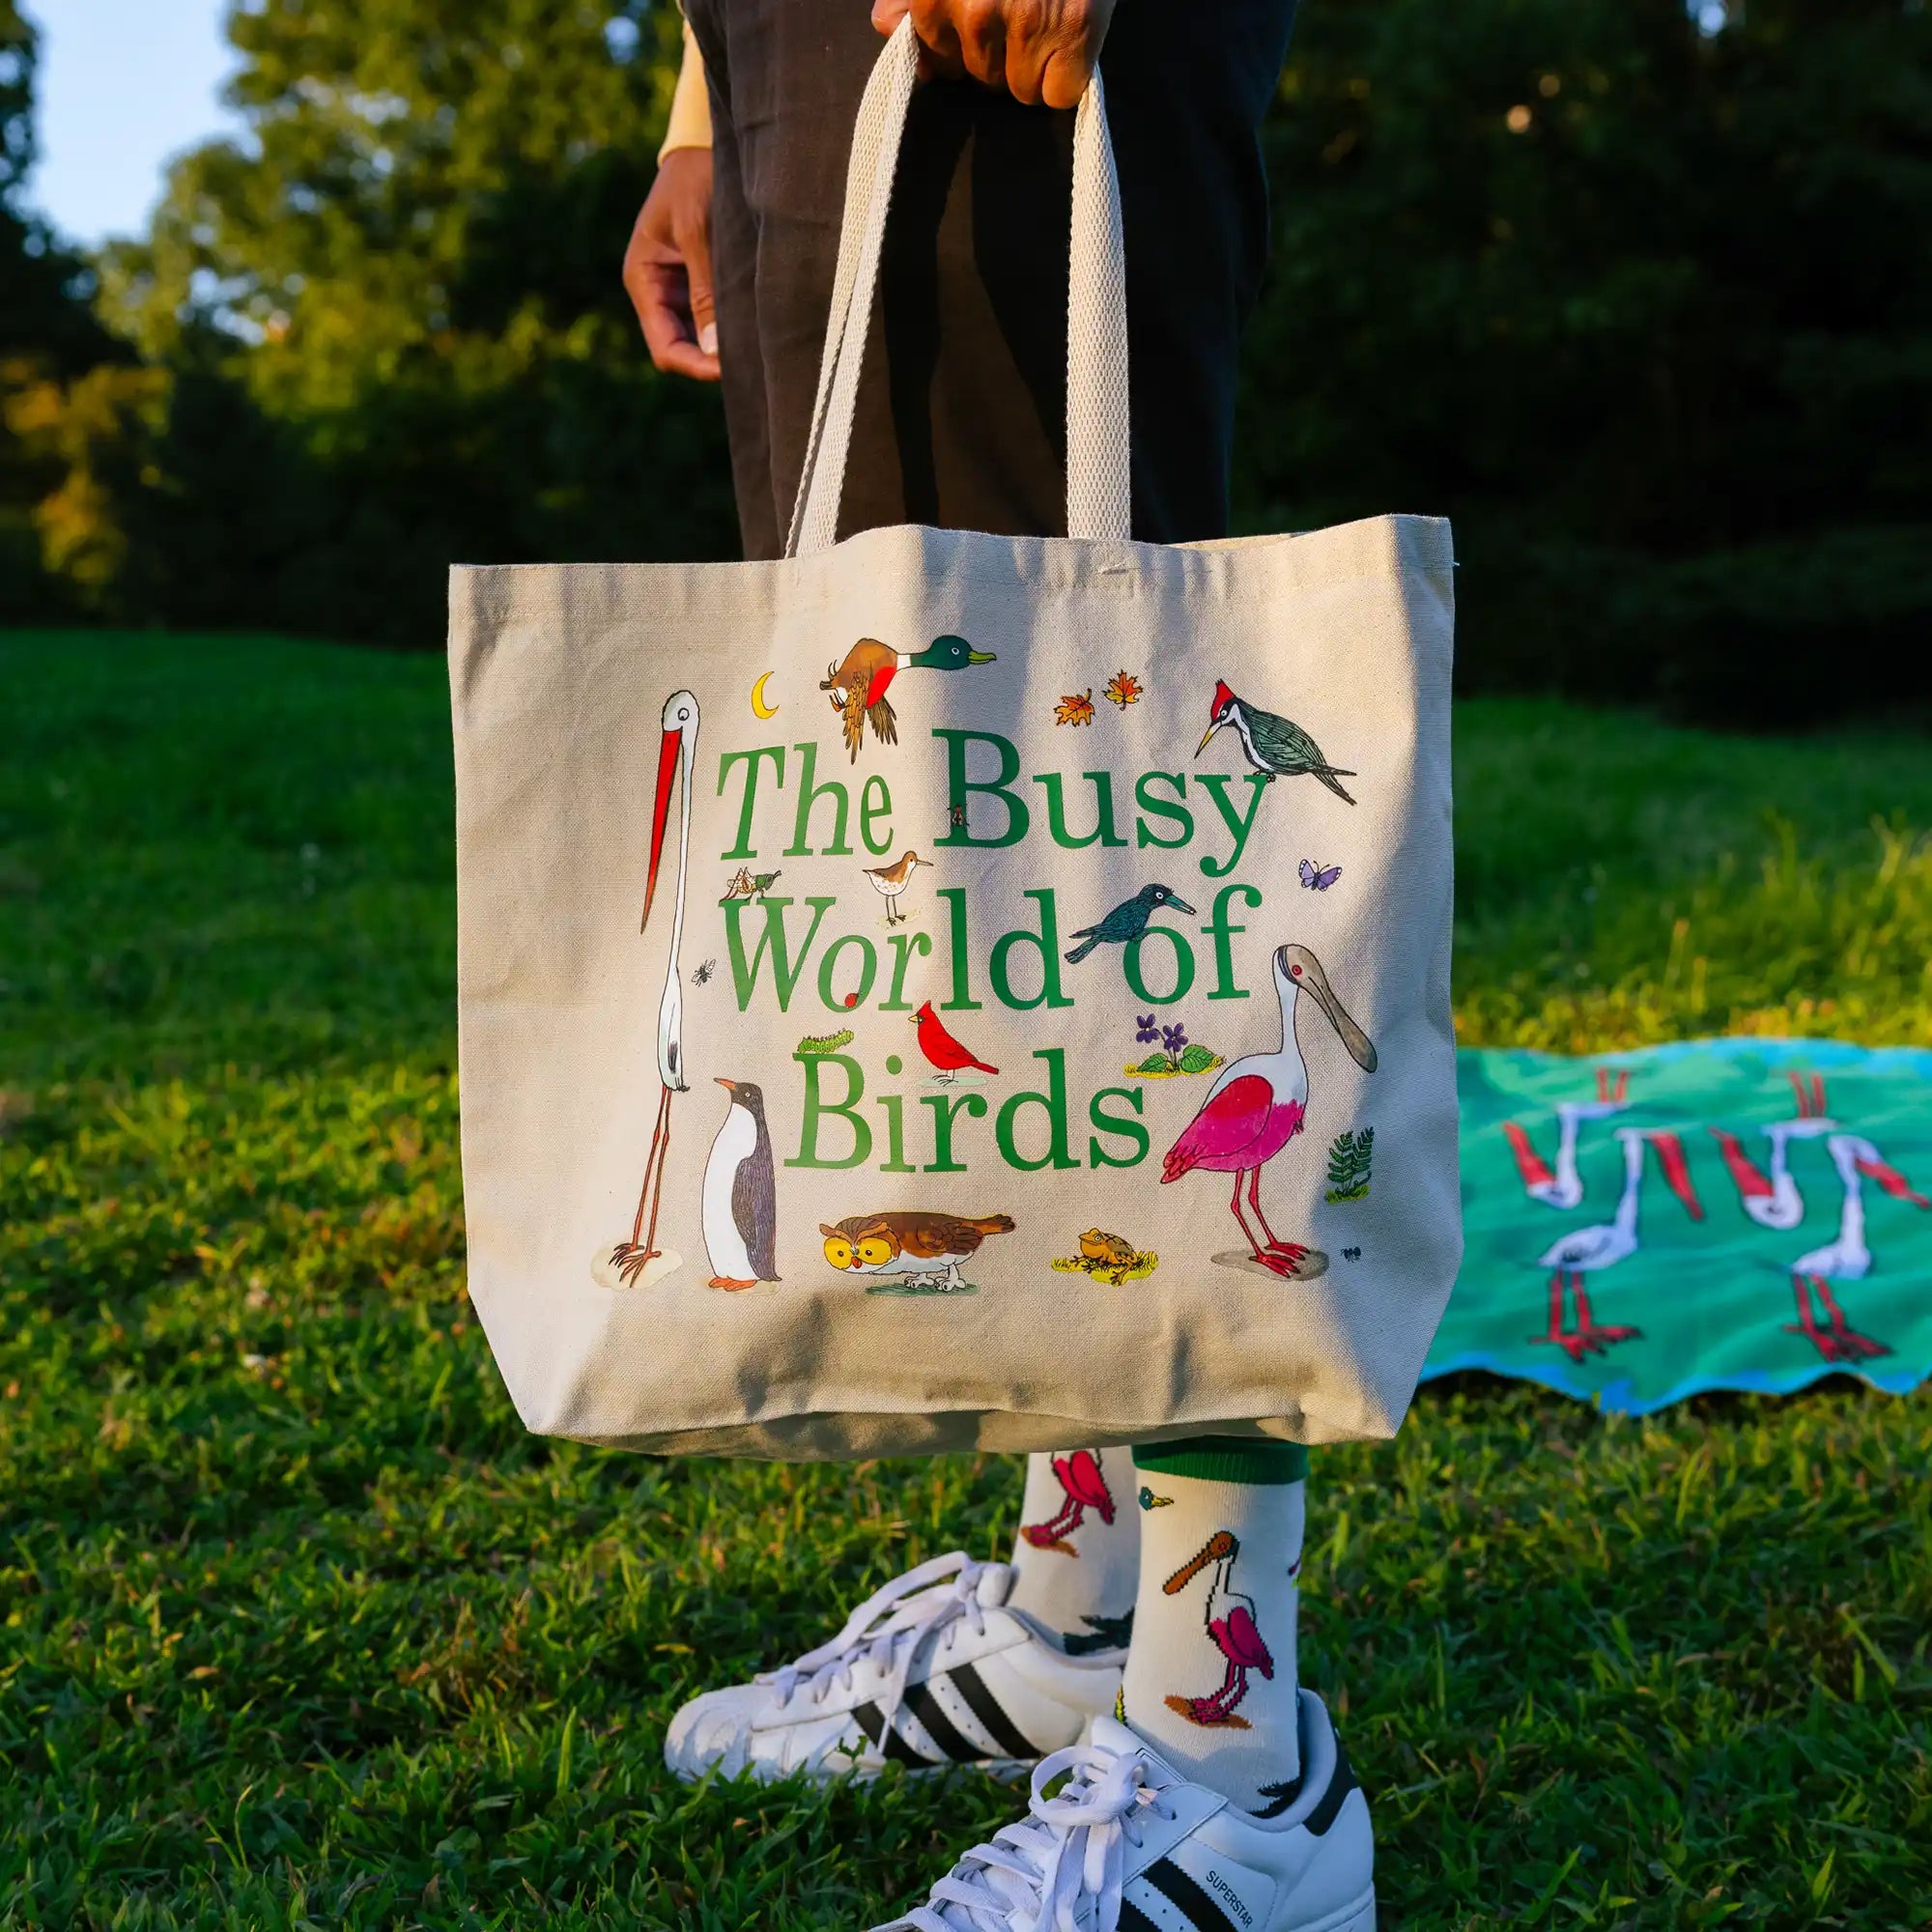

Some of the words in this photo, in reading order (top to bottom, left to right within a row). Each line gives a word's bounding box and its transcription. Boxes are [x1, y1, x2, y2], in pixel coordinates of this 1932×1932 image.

[715, 741, 895, 861] The
[932, 728, 1270, 878] Busy
[718, 887, 1074, 1013] World
[1122, 884, 1264, 1006] of
[783, 1047, 1151, 1174] Birds
[1207, 1870, 1253, 1928] SUPERSTAR
